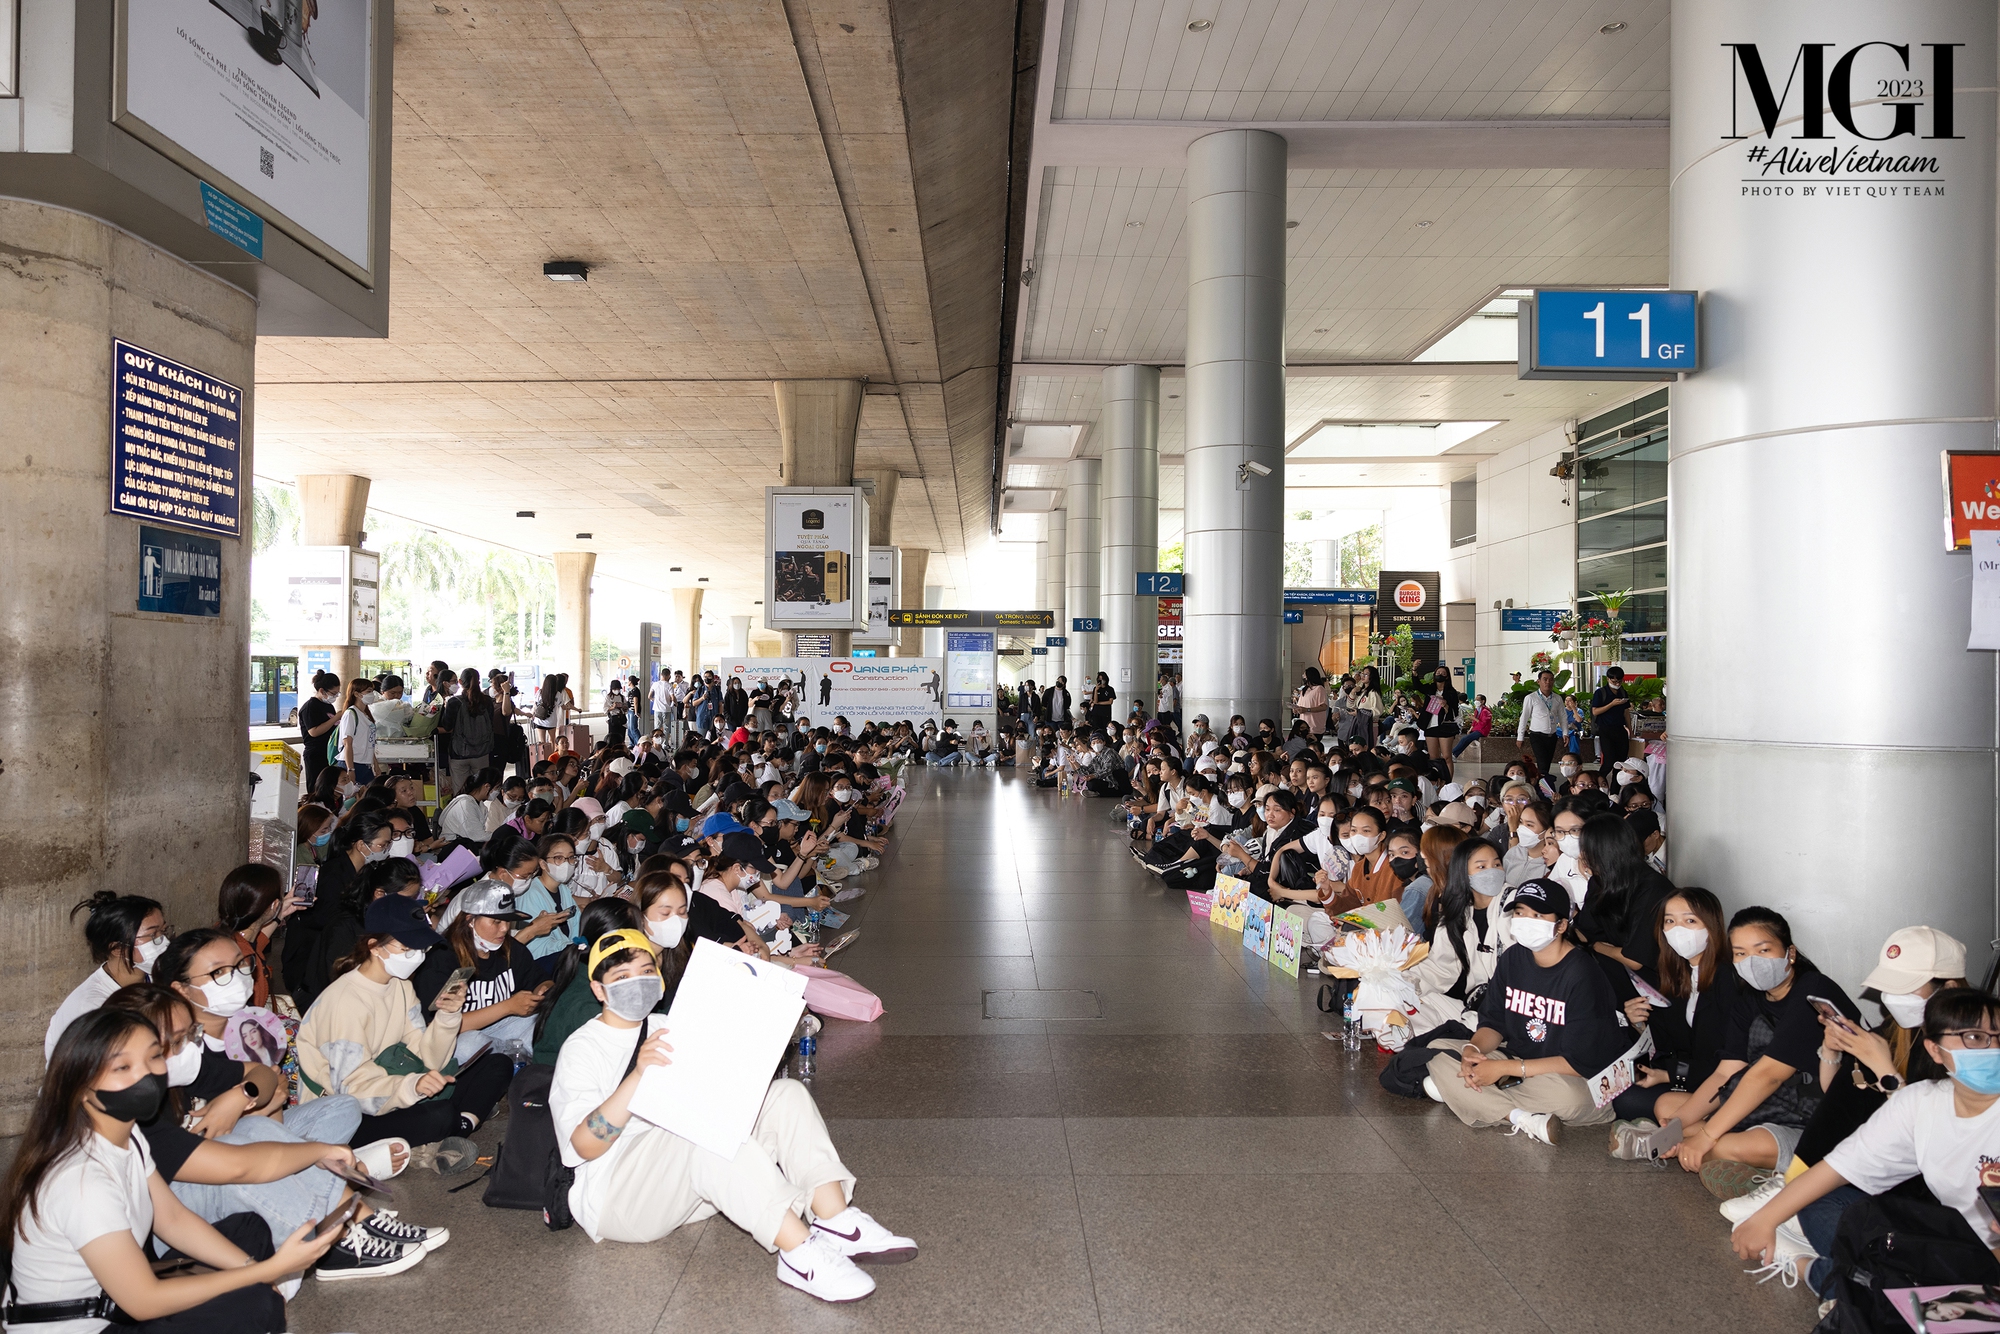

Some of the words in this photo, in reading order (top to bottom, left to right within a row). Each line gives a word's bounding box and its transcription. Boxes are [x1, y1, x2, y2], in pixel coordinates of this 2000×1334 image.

[1583, 302, 1650, 358] 11
[1657, 343, 1685, 359] GF
[124, 352, 155, 371] QUÝ
[158, 364, 202, 390] KHÁCH
[204, 382, 226, 399] LƯU
[228, 390, 236, 403] Ý
[1148, 575, 1171, 592] 12
[1080, 620, 1093, 630] 13
[734, 665, 770, 673] QUANG
[829, 662, 889, 673] QUANG
[892, 664, 928, 673] PHÁT
